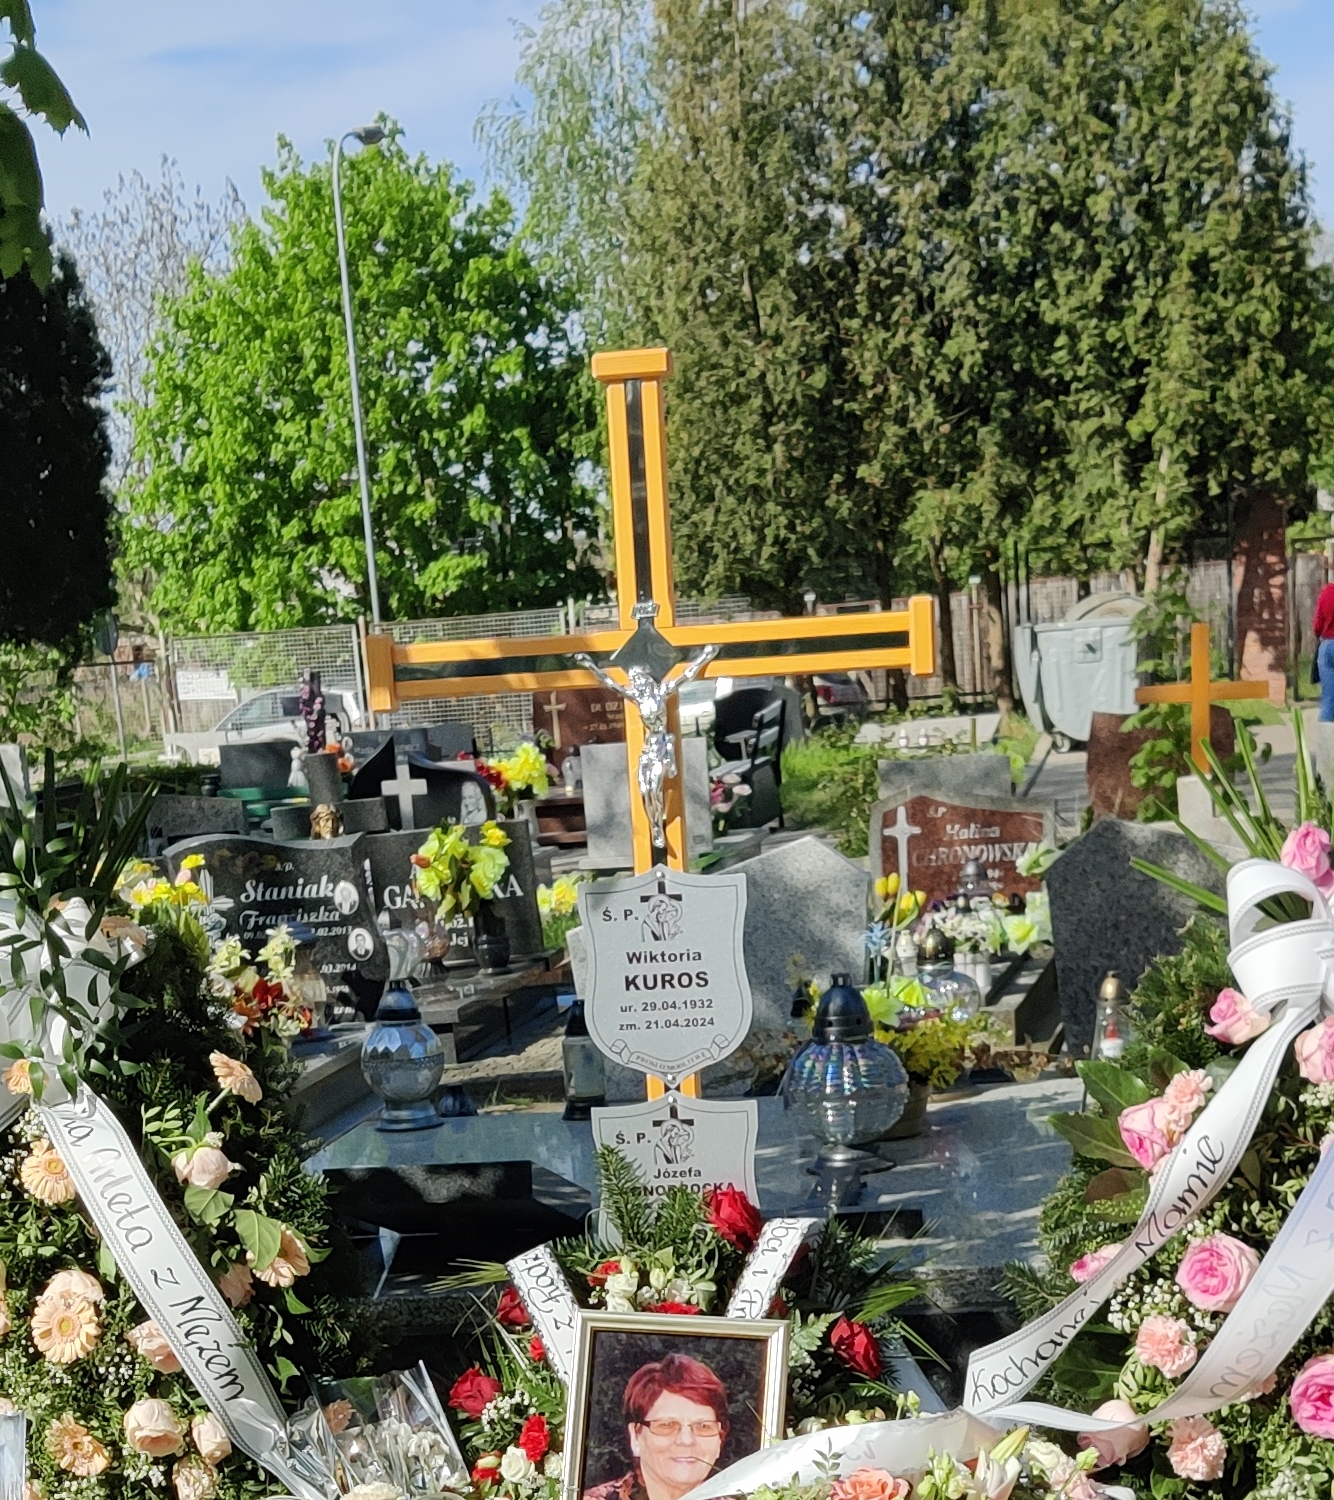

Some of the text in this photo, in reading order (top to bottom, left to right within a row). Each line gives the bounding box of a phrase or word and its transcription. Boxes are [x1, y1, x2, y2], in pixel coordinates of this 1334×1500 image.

[240, 875, 335, 903] Staniak
[626, 949, 702, 964] Wiktoria
[624, 971, 709, 991] KUROS
[620, 998, 714, 1013] ur. 29.04.1932
[619, 1016, 715, 1031] zm. 21.04.2024
[653, 1167, 702, 1179] Józefa
[1134, 1134, 1225, 1257] Mamie
[151, 1267, 181, 1291] z
